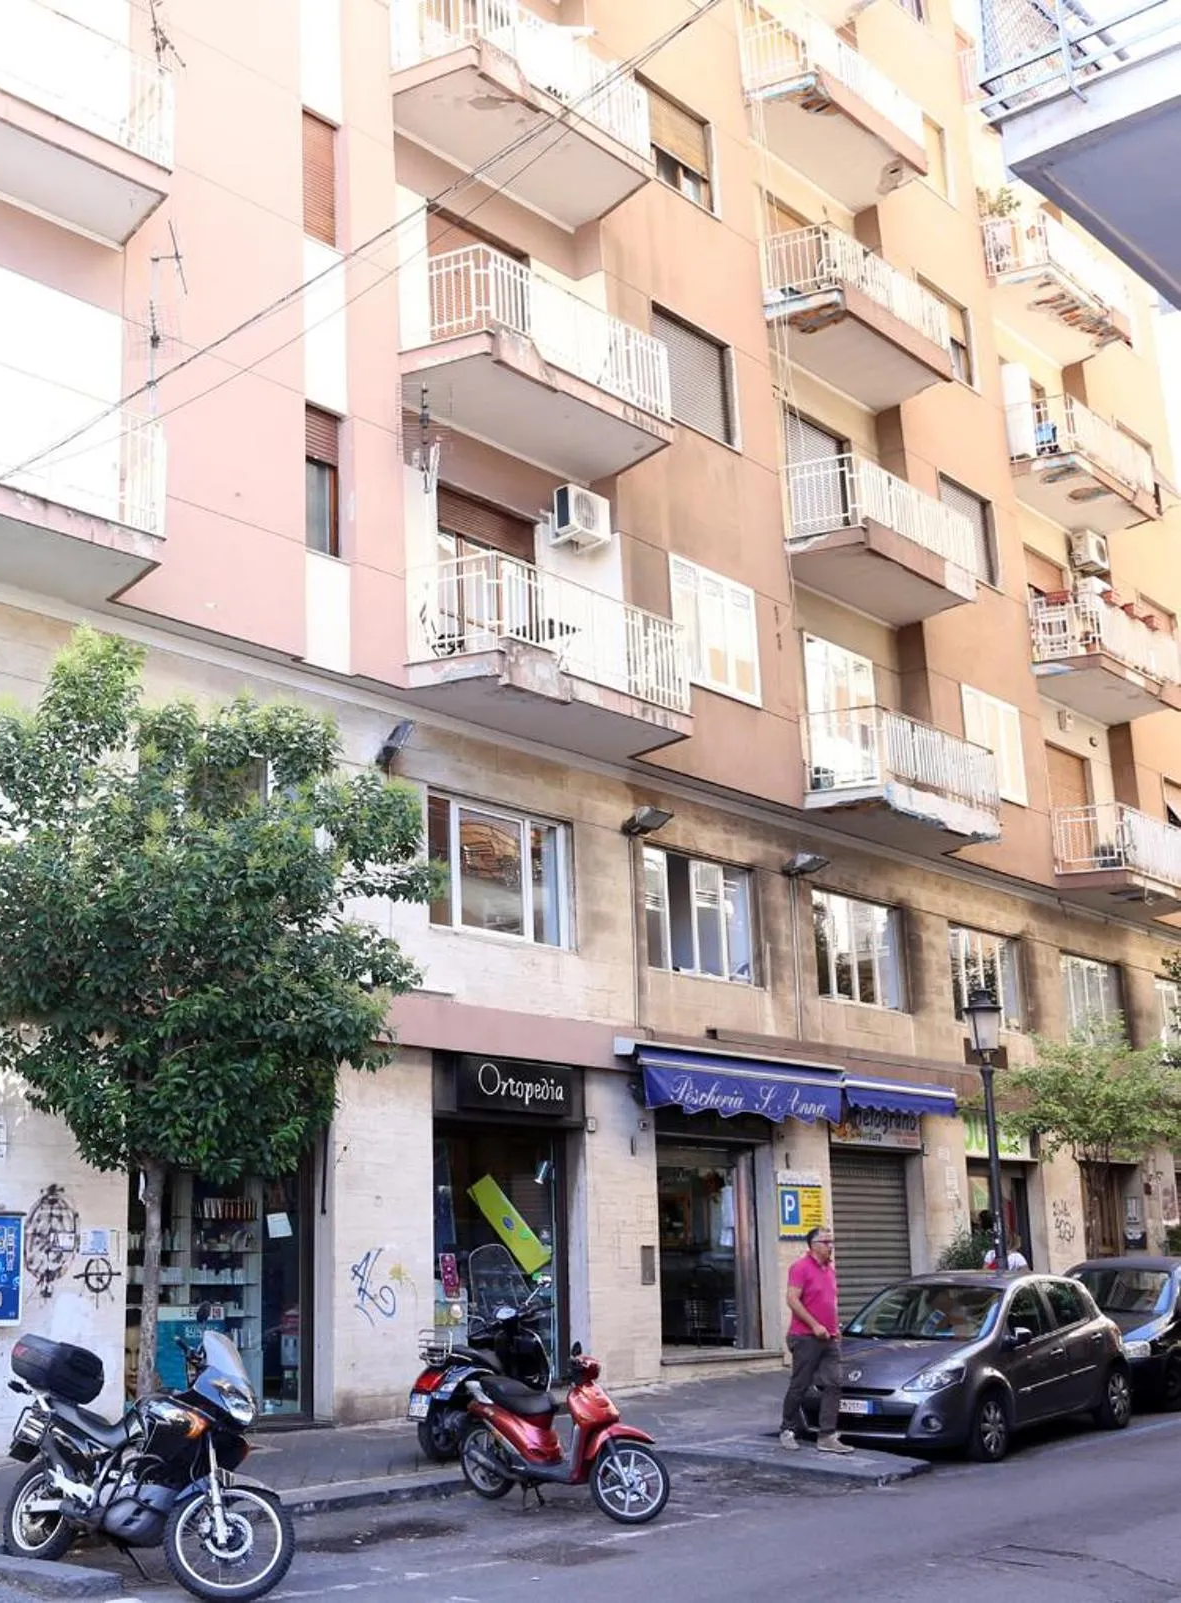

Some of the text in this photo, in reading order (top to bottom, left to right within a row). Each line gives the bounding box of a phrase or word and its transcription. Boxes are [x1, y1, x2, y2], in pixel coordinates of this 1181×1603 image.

[479, 1063, 564, 1105] Ortopedia
[671, 1074, 745, 1109] Pescheria
[777, 1087, 828, 1117] Anna
[784, 1194, 796, 1221] P
